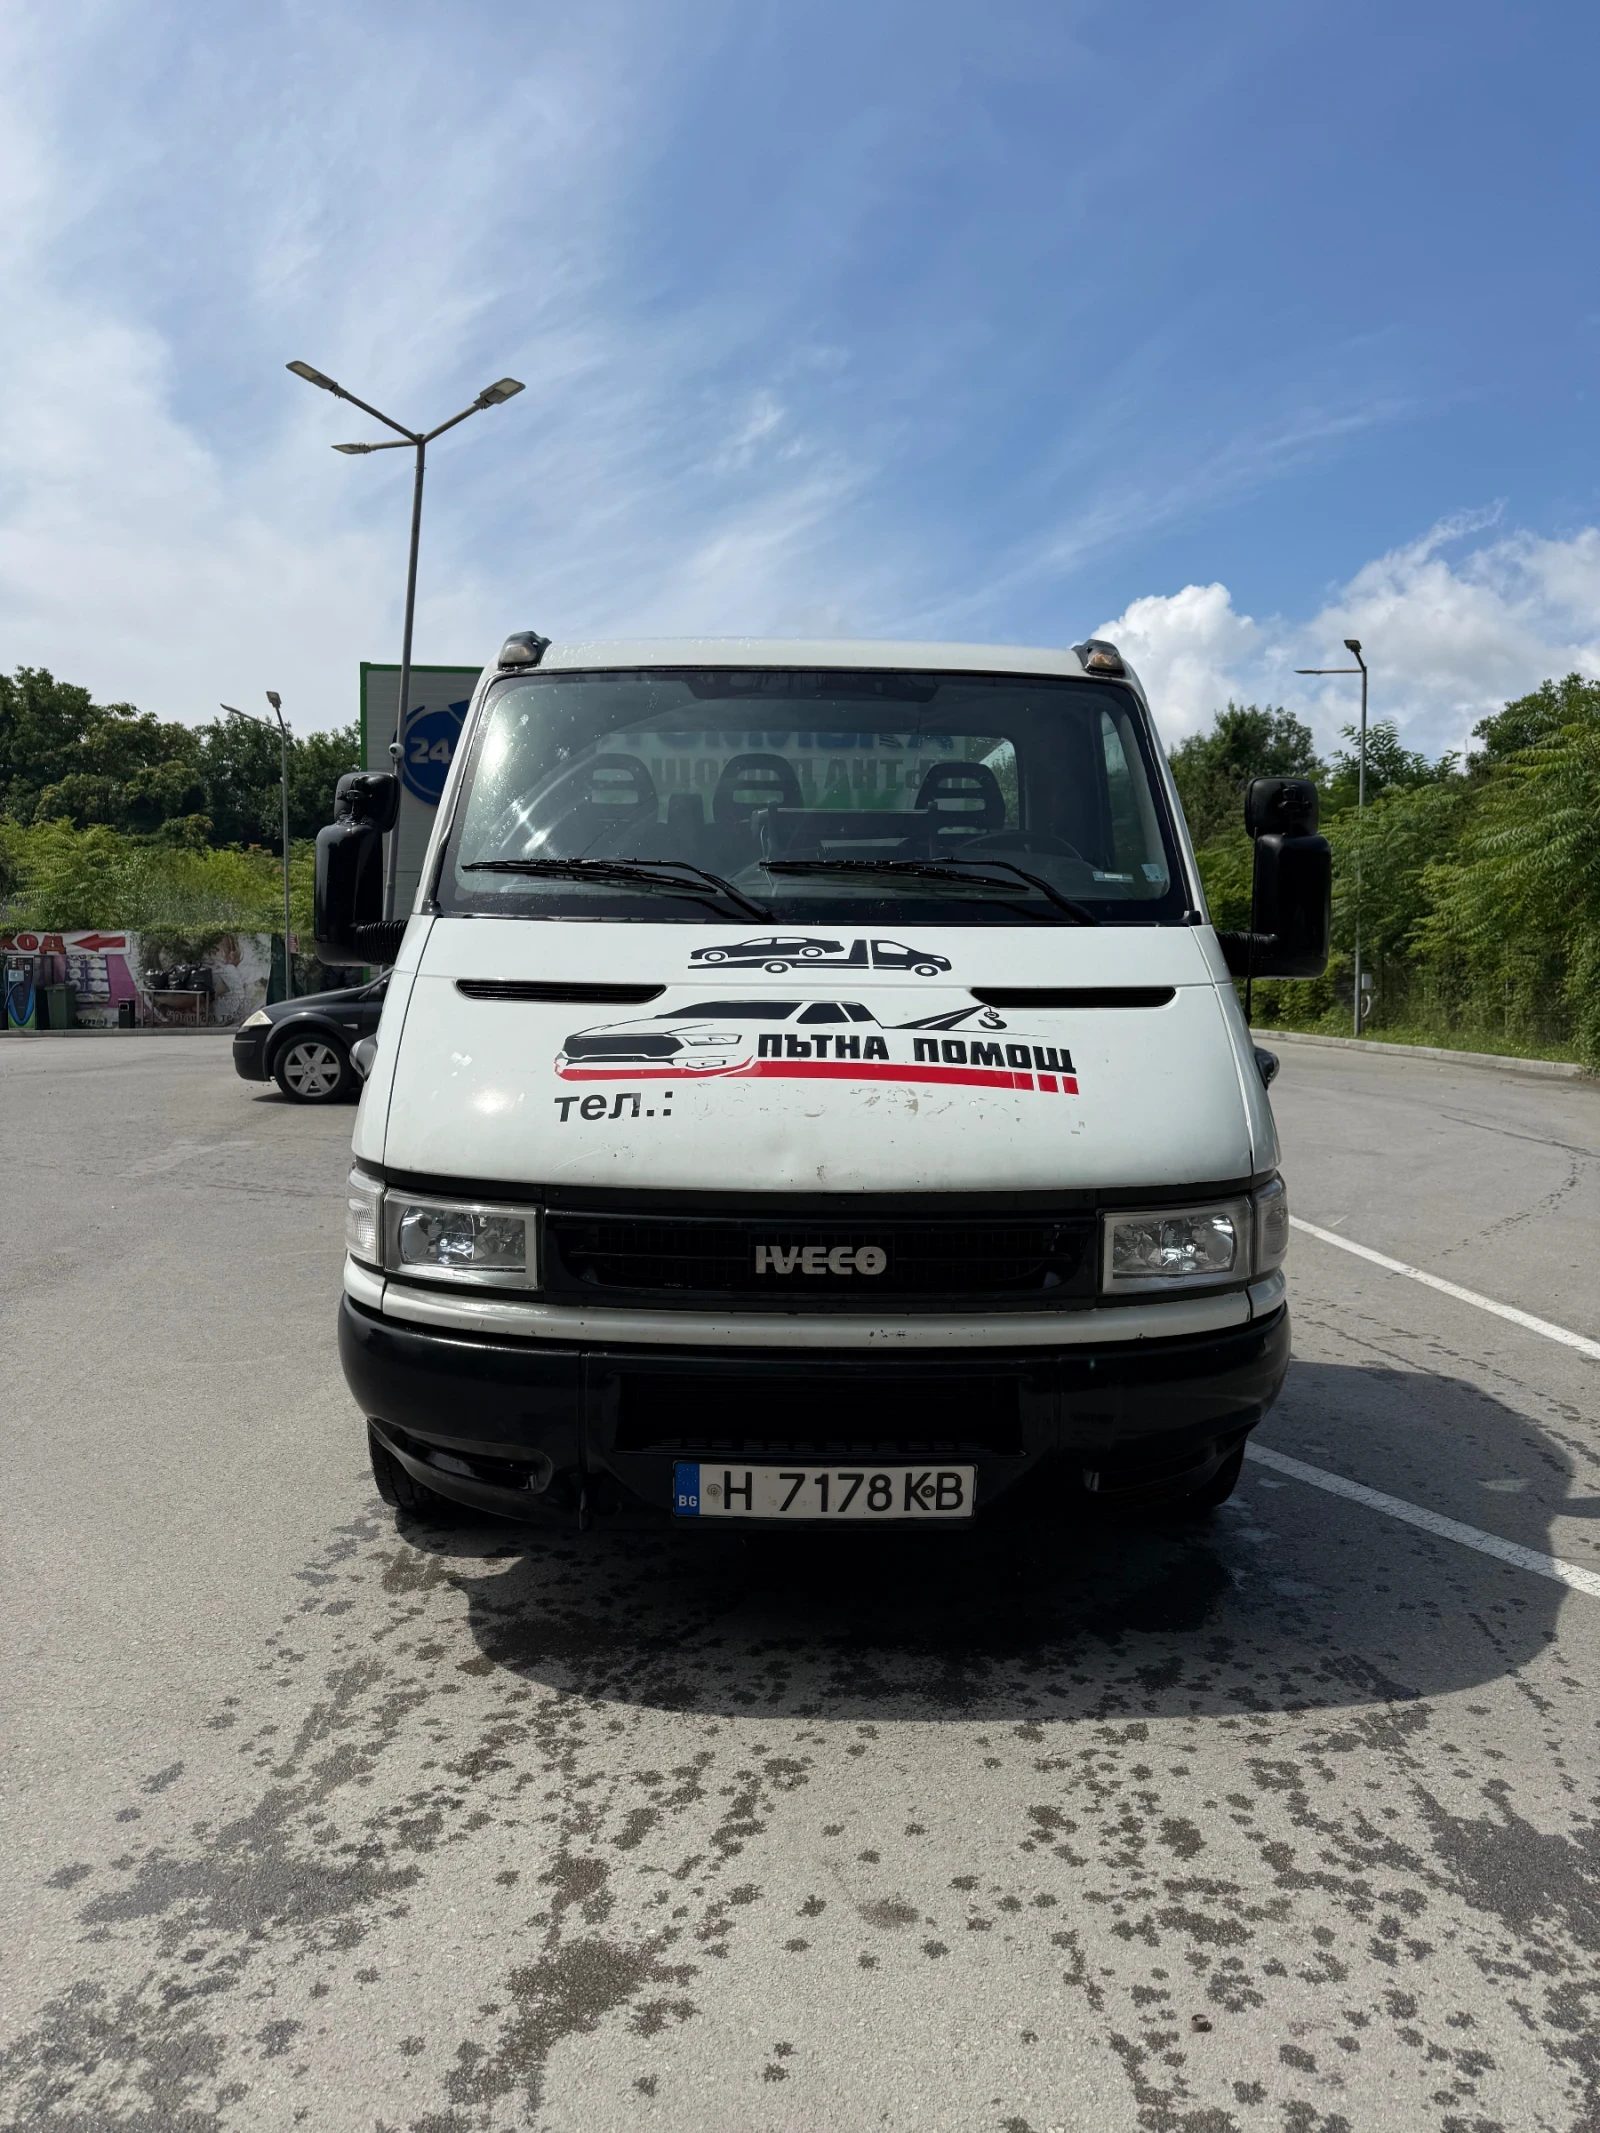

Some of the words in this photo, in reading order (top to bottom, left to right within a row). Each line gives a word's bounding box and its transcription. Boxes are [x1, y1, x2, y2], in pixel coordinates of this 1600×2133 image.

[410, 737, 452, 763] 24
[757, 1033, 890, 1060] ПЪТНА
[913, 1037, 1077, 1074] ПОМОЩ
[554, 1091, 673, 1122] тел.:
[756, 1245, 887, 1275] IVECO
[678, 1495, 698, 1507] BG
